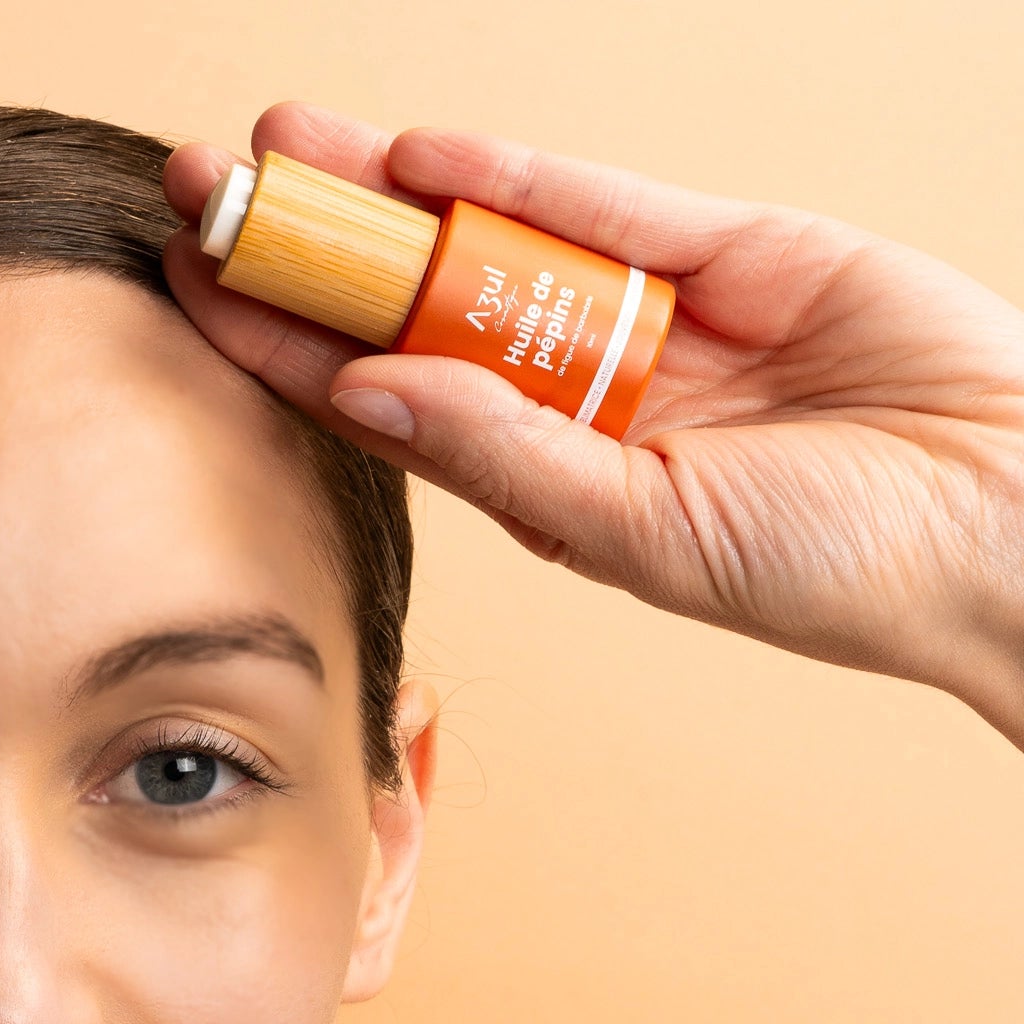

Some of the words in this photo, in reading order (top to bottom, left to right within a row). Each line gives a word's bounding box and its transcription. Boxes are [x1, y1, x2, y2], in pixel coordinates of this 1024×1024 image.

[503, 303, 542, 366] Huile
[531, 271, 554, 301] de
[532, 286, 575, 371] pépins
[571, 332, 579, 344] de
[561, 345, 575, 366] figue
[557, 365, 566, 376] de
